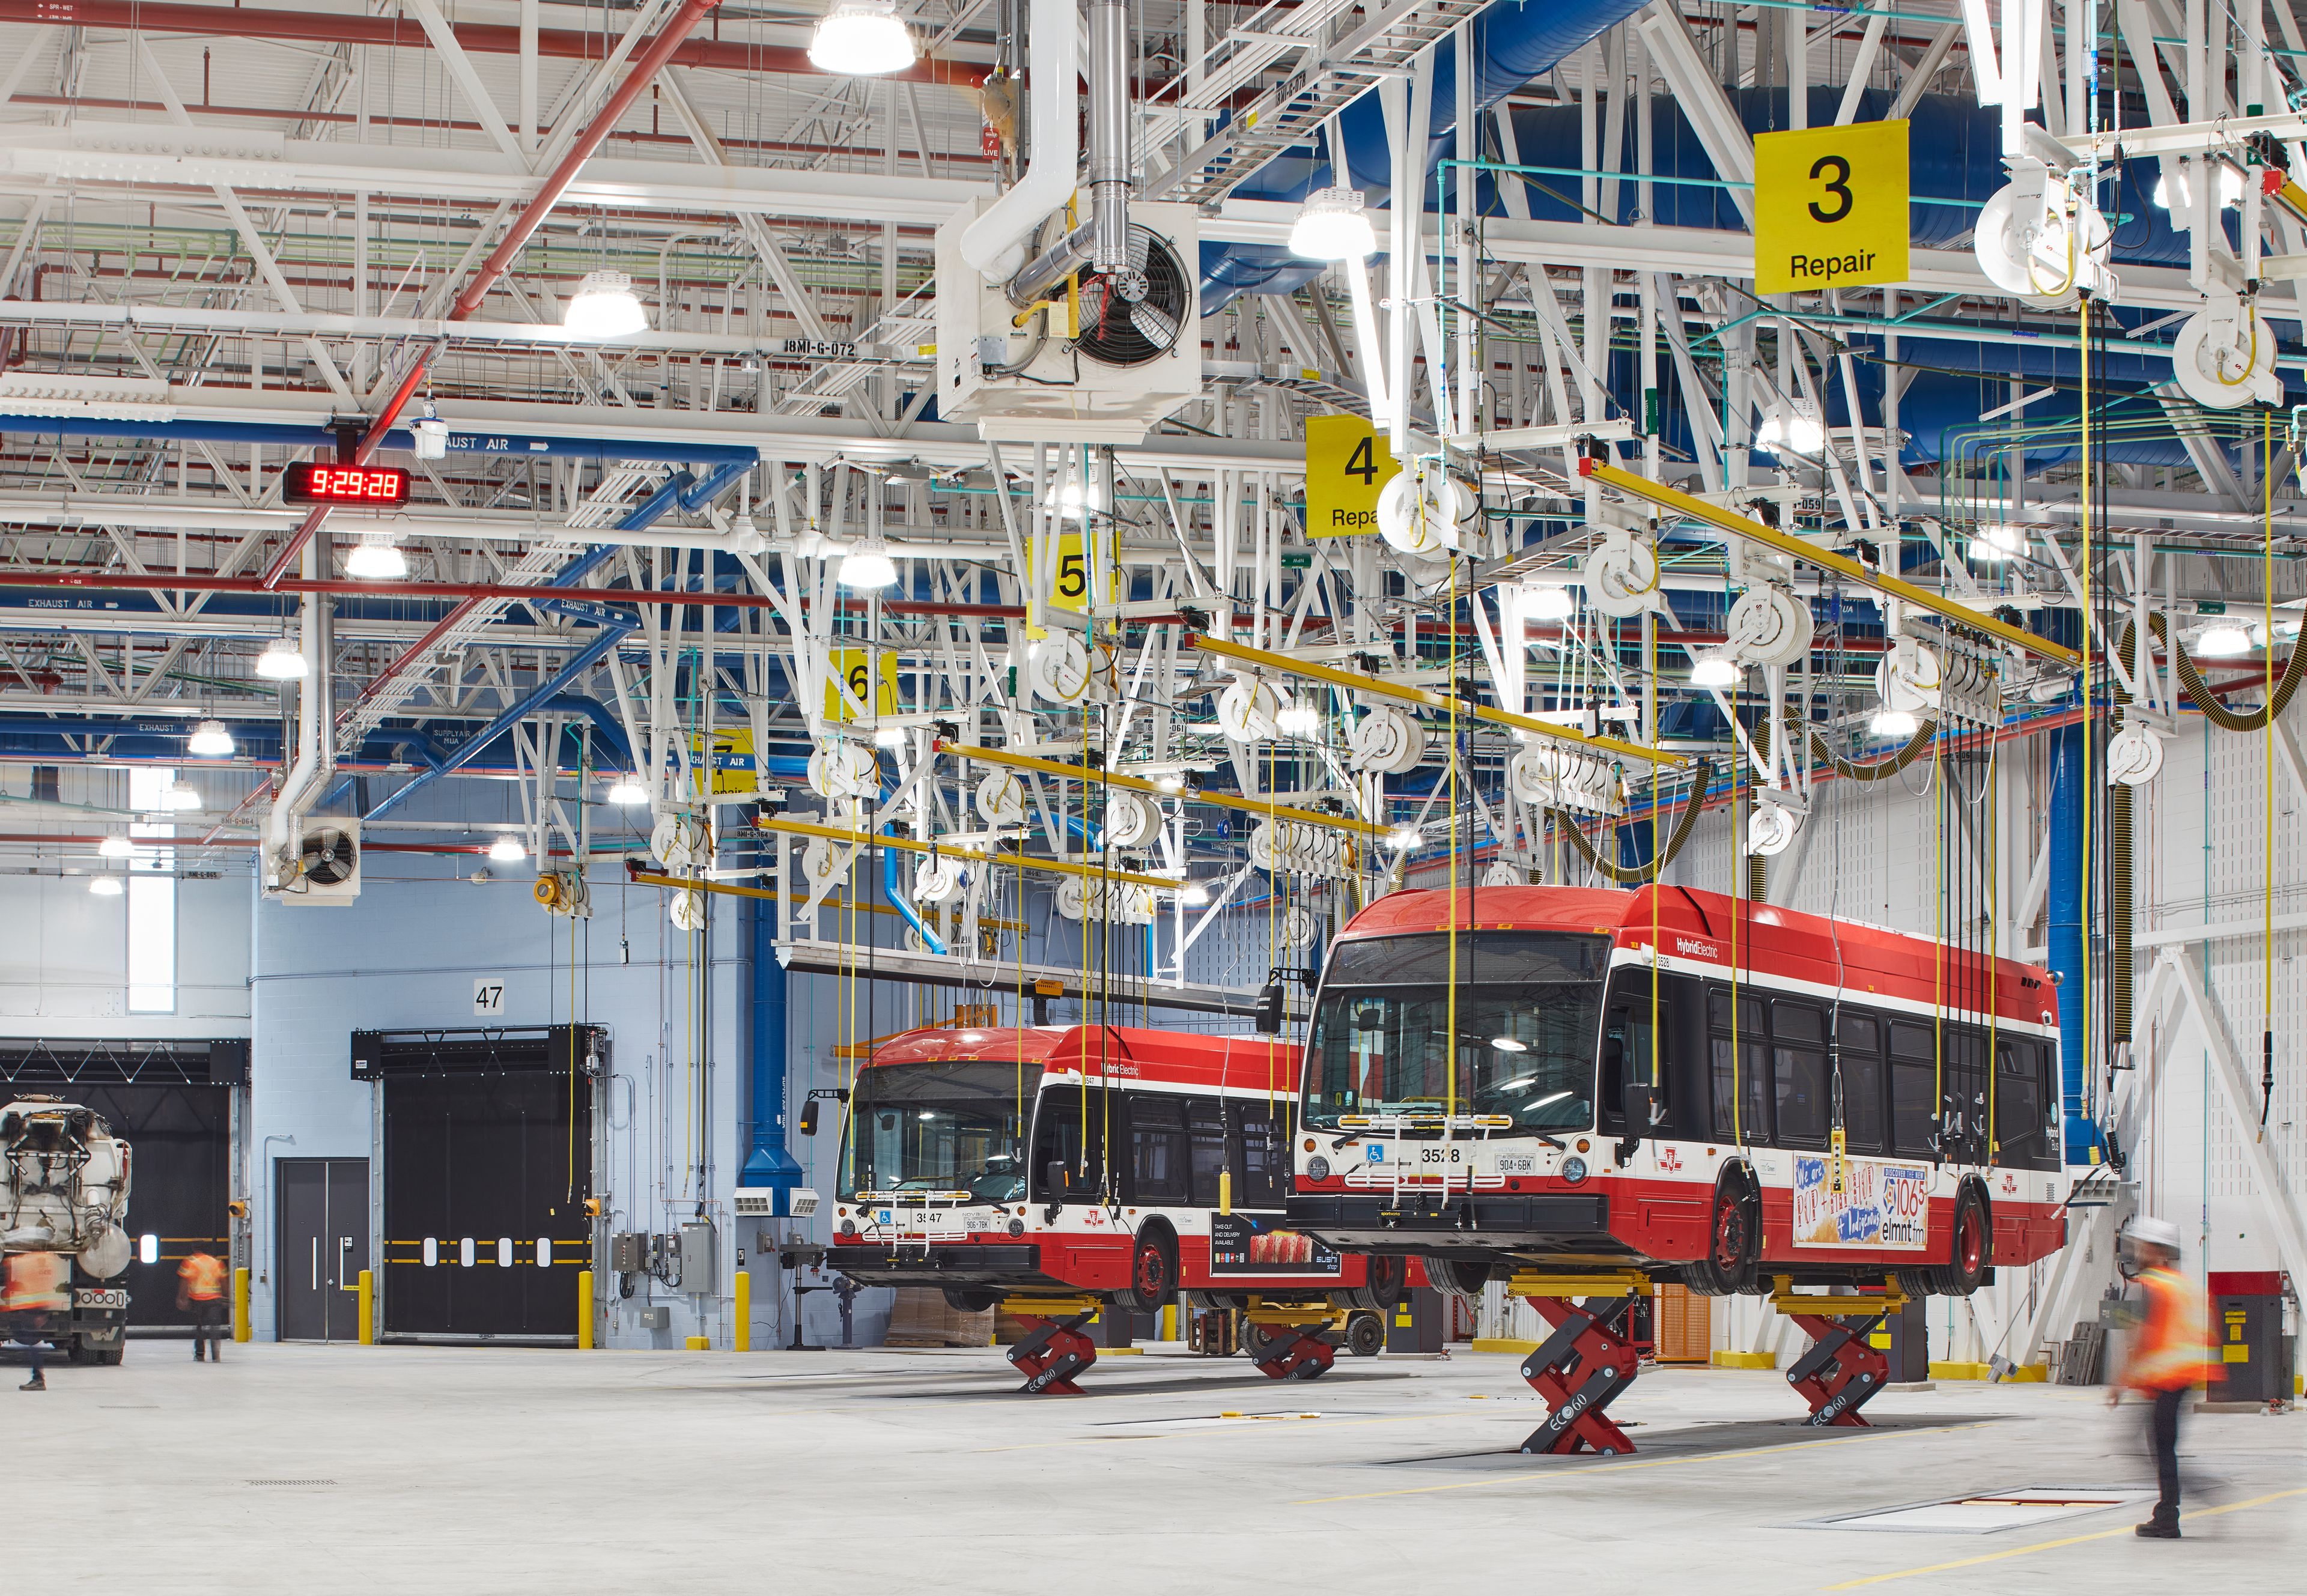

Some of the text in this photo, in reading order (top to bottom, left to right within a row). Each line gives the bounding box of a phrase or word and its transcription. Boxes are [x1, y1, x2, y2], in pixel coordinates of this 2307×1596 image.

[1807, 155, 1853, 224] 3
[1790, 249, 1876, 282] Repair
[486, 438, 508, 450] AIR
[1345, 436, 1378, 486] 4
[312, 469, 398, 498] 9:29:28
[1332, 509, 1378, 528] Repa
[1059, 554, 1086, 597] 5
[28, 599, 93, 608] EXHAUST AIR
[561, 599, 606, 617] EXHAUST AIR
[849, 665, 868, 702] 6
[729, 757, 745, 766] AIR
[1677, 937, 1718, 959] HybridElectric
[1658, 956, 1670, 968] 3528
[476, 986, 502, 1009] 47
[2046, 1126, 2059, 1140] Hybrid
[1500, 1160, 1531, 1170] 904 6BK
[1797, 1164, 1823, 1186] We are
[1885, 1168, 1906, 1178] DISCOVER
[1797, 1189, 1818, 1228] POP
[1853, 1166, 1874, 1206] HOP
[1848, 1210, 1880, 1240] Indigenous
[1882, 1218, 1924, 1243] elmnt fm
[1316, 1253, 1337, 1263] sushi
